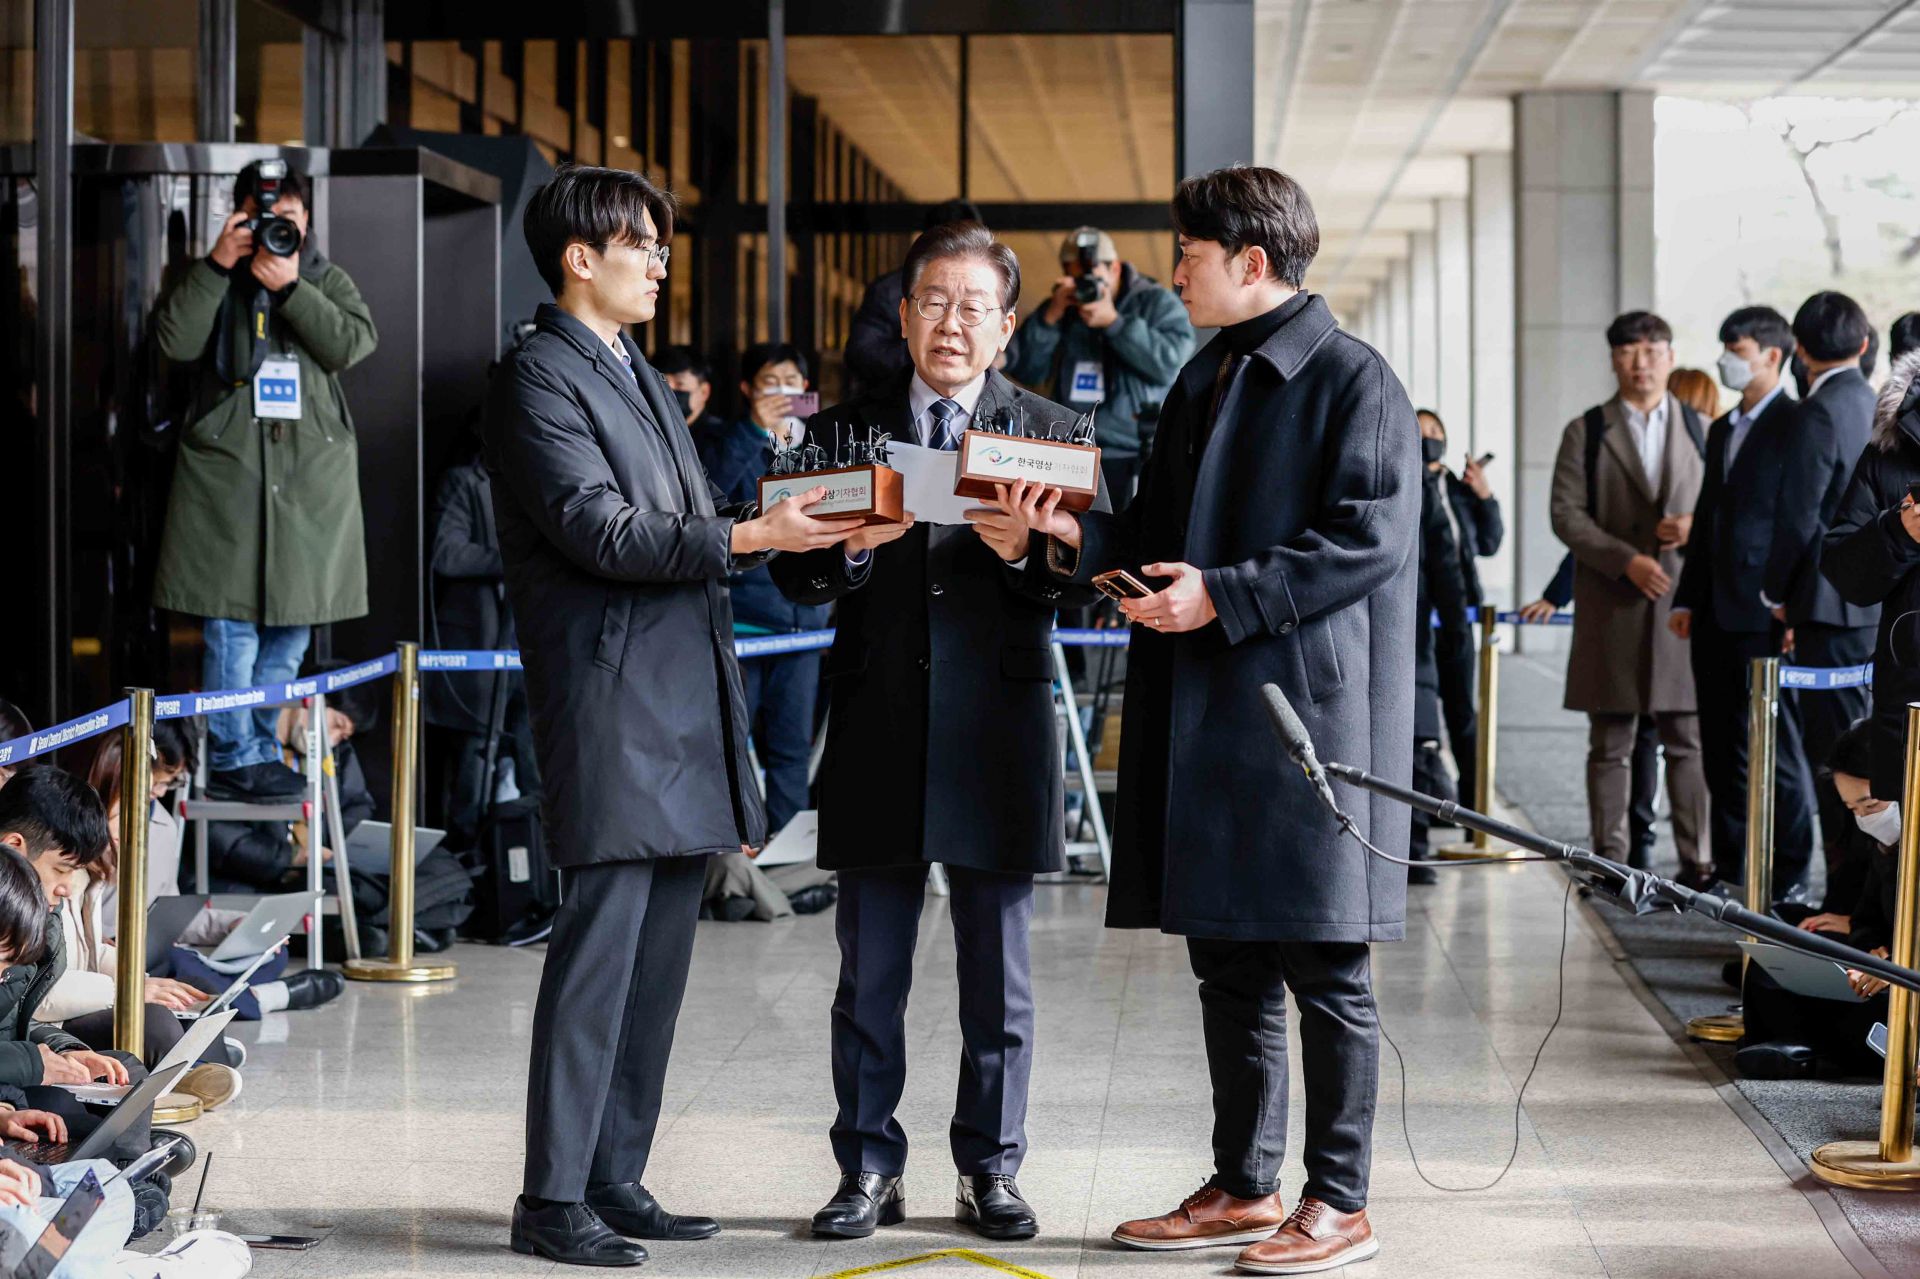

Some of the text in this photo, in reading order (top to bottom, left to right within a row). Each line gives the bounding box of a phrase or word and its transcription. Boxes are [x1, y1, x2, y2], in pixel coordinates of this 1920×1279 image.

[37, 736, 49, 751] Seoul
[48, 732, 62, 747] Central
[95, 713, 109, 730] Service
